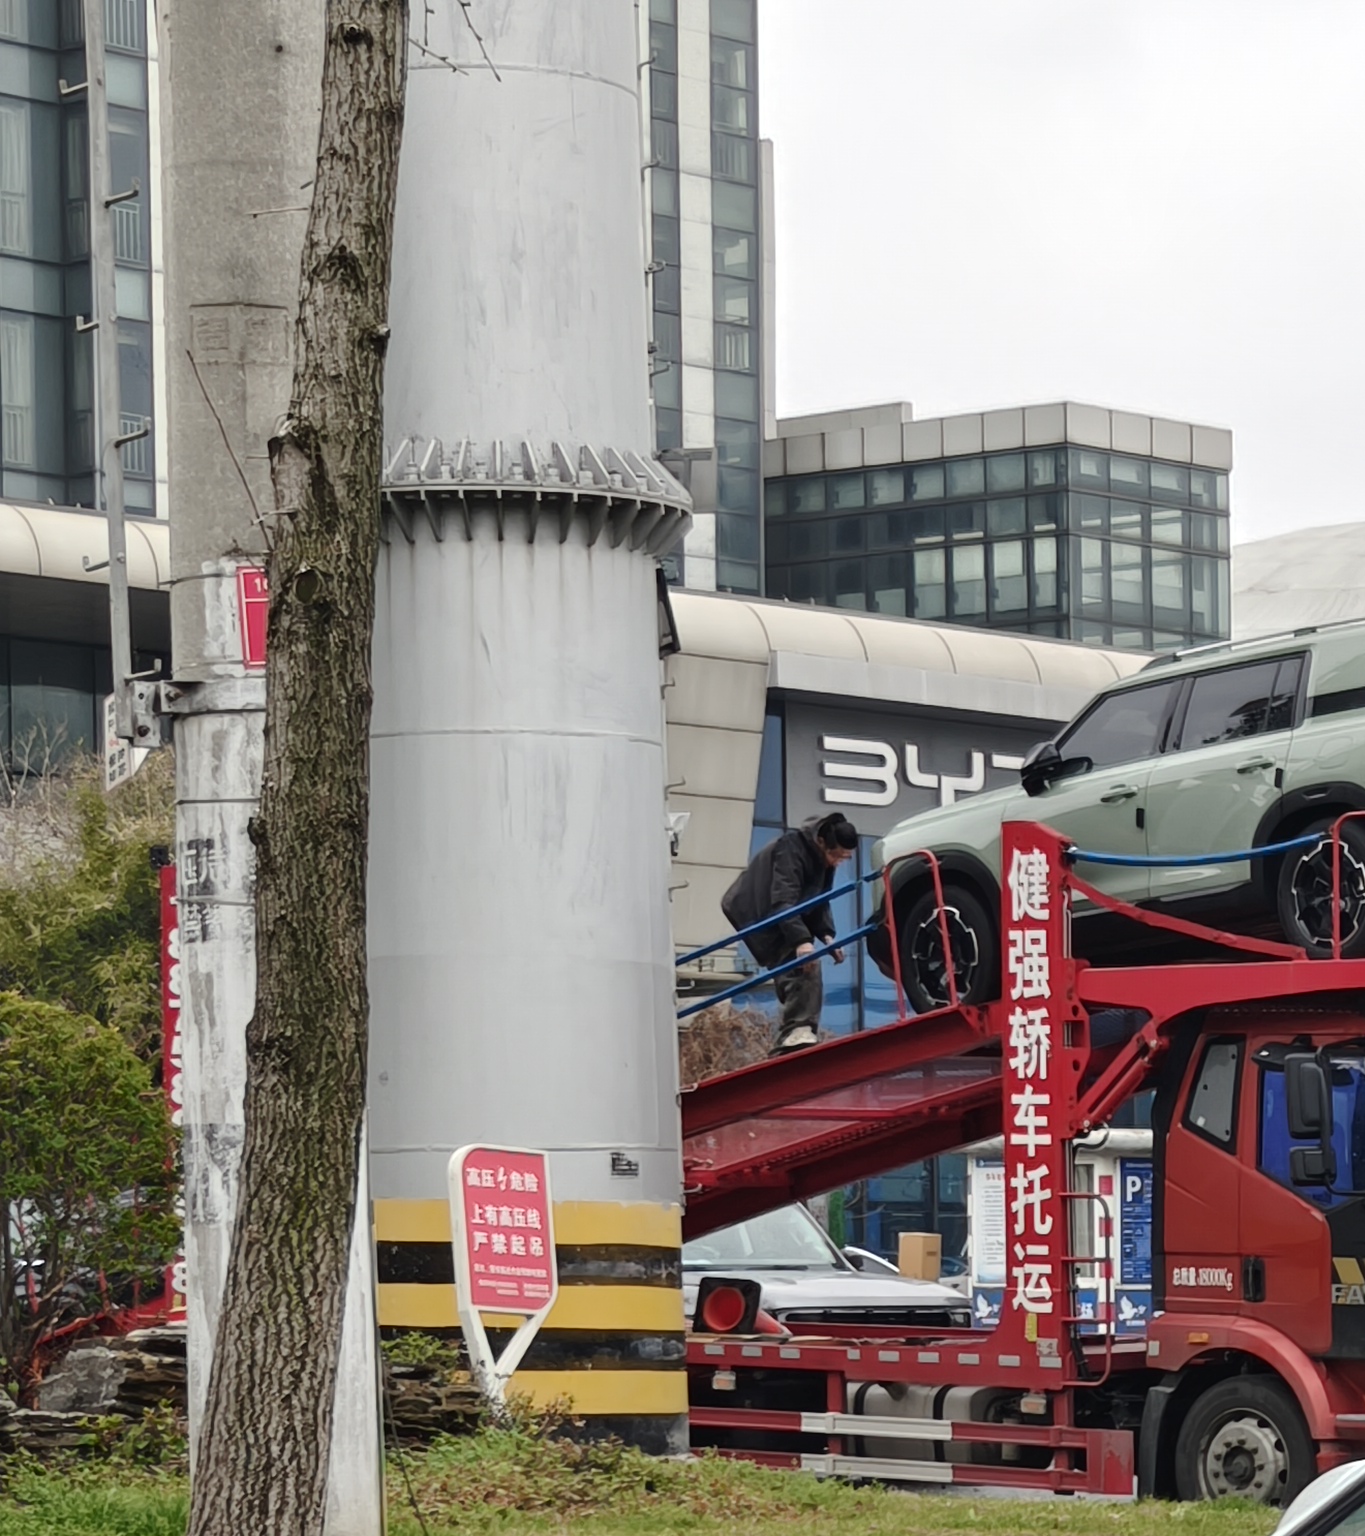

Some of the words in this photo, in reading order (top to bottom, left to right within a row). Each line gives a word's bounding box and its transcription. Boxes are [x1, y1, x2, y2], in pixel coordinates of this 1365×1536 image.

[823, 735, 1025, 807] BY
[1008, 848, 1054, 1315] 健强轿车托运
[1126, 1175, 1142, 1203] P
[471, 1203, 542, 1230] 上有高压线
[473, 1231, 544, 1257] 严禁起吊
